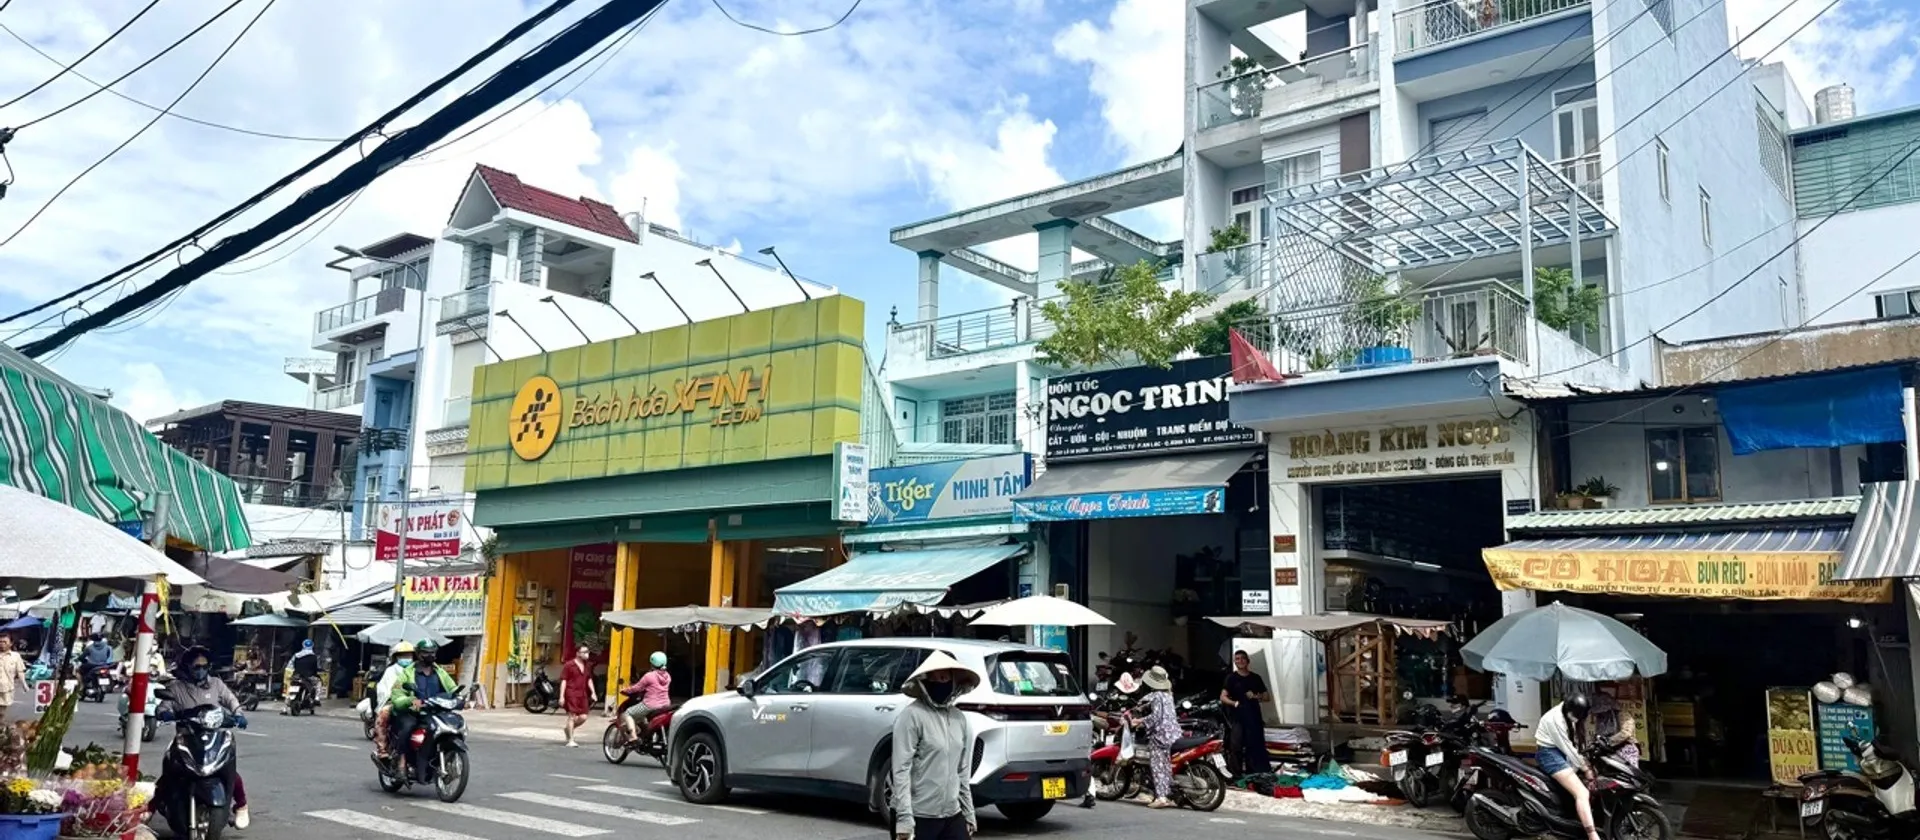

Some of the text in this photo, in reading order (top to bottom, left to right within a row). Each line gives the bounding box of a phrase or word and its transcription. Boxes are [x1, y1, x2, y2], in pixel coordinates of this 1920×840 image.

[569, 364, 773, 428] Bách hóa XANH
[1048, 377, 1099, 395] UỐN TÓC
[1050, 390, 1132, 423] NGỌC
[1156, 424, 1186, 436] TRANG
[1290, 420, 1510, 459] HOÀNG KIM NGỌC
[886, 477, 934, 510] Tiger
[953, 470, 1024, 500] MINH TÂM
[395, 510, 446, 533] TN PHÁT
[1522, 552, 1580, 580] CÔ
[1591, 554, 1694, 584] HOA
[1698, 555, 1718, 584] BÚN
[1722, 555, 1746, 584] RIÊU
[1756, 554, 1778, 586] BÚN
[1582, 582, 1618, 592] NGUYỄN
[38, 682, 52, 704] 3
